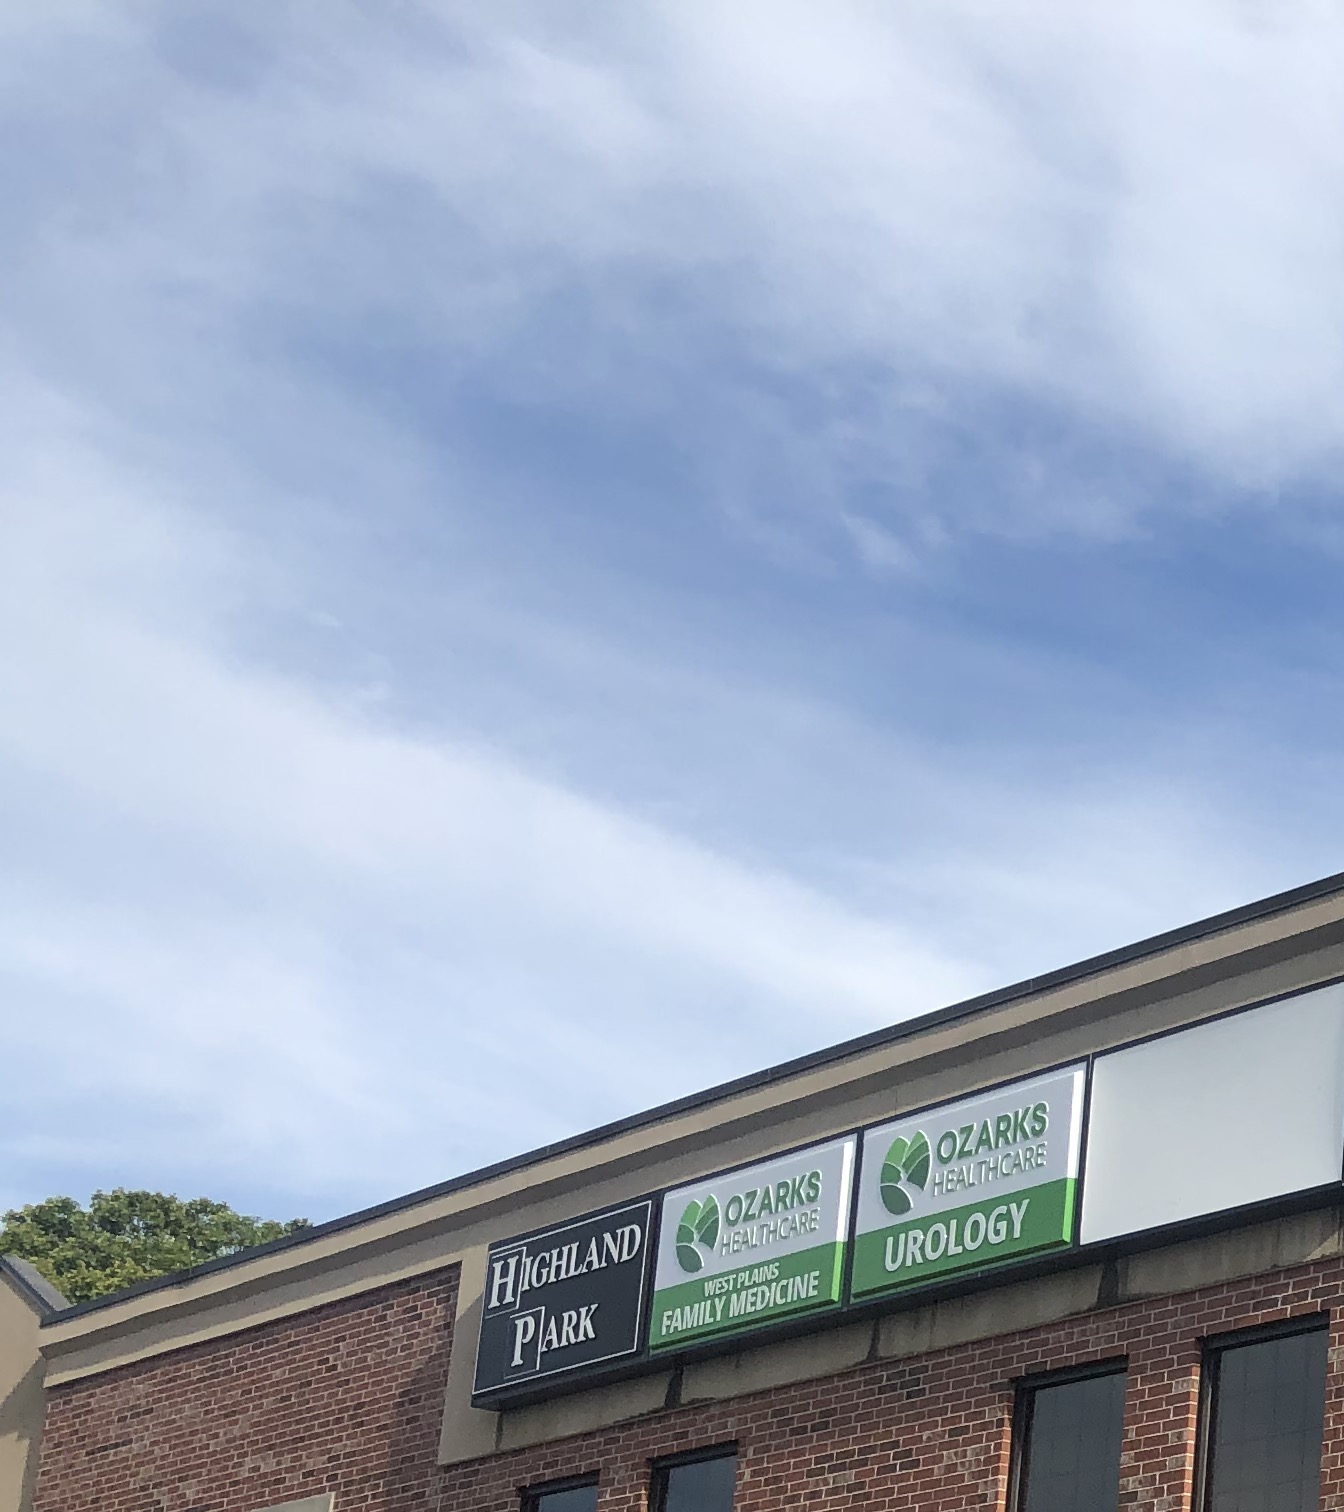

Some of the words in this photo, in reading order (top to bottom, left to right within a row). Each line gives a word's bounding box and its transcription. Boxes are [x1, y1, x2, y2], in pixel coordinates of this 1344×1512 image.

[936, 1101, 1050, 1165] OZARKS
[724, 1169, 823, 1227] OZARKS
[931, 1141, 1047, 1197] HEALTHCARE
[721, 1207, 820, 1257] HEALTHCARE
[884, 1199, 1030, 1272] UROLOGY
[487, 1223, 641, 1310] HIGHLAND
[703, 1272, 737, 1297] WEST
[738, 1262, 780, 1293] PLAINS
[661, 1292, 725, 1336] FAMILY
[729, 1271, 819, 1319] MEDICINE
[511, 1304, 599, 1368] PARK
